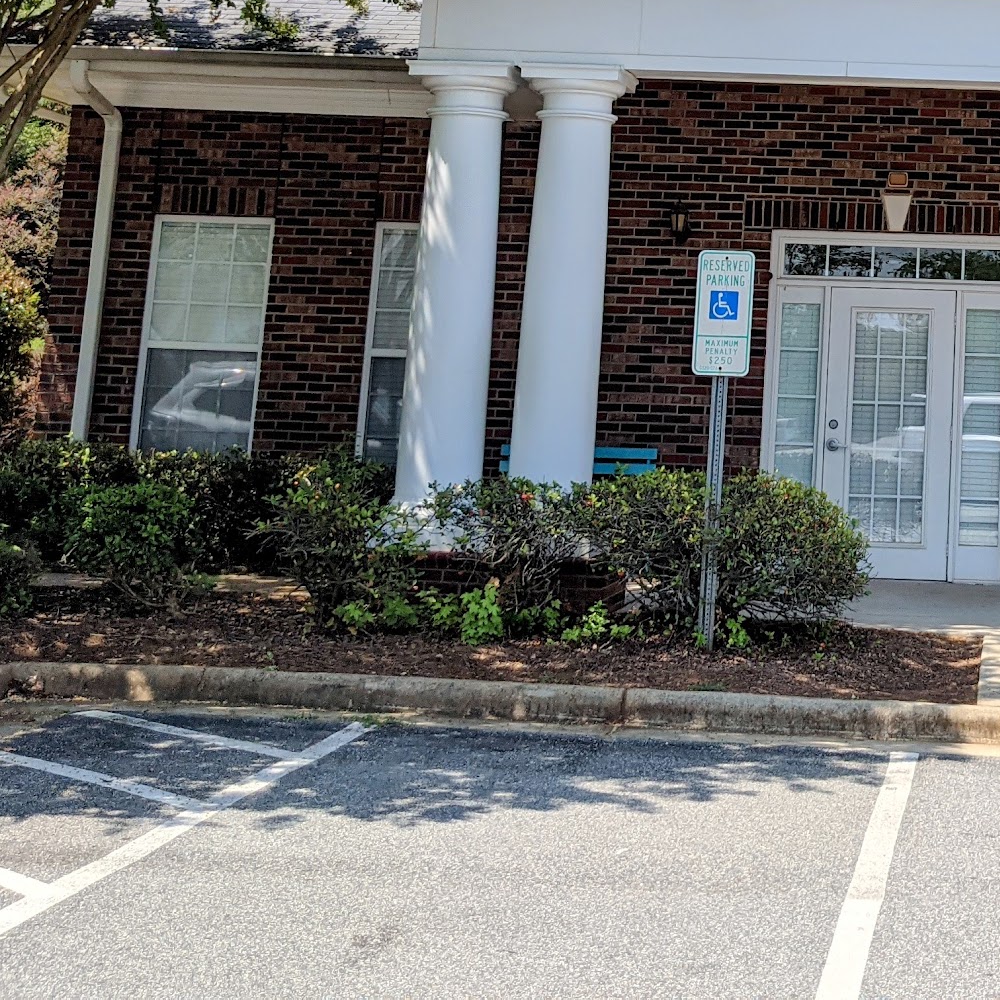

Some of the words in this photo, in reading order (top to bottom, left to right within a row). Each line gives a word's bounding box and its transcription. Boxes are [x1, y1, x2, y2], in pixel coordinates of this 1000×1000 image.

[703, 259, 750, 272] RESERVED
[706, 274, 745, 287] PARKING
[705, 339, 739, 347] MAXIMUM
[705, 347, 738, 355] PENALTY
[708, 356, 733, 365] $250
